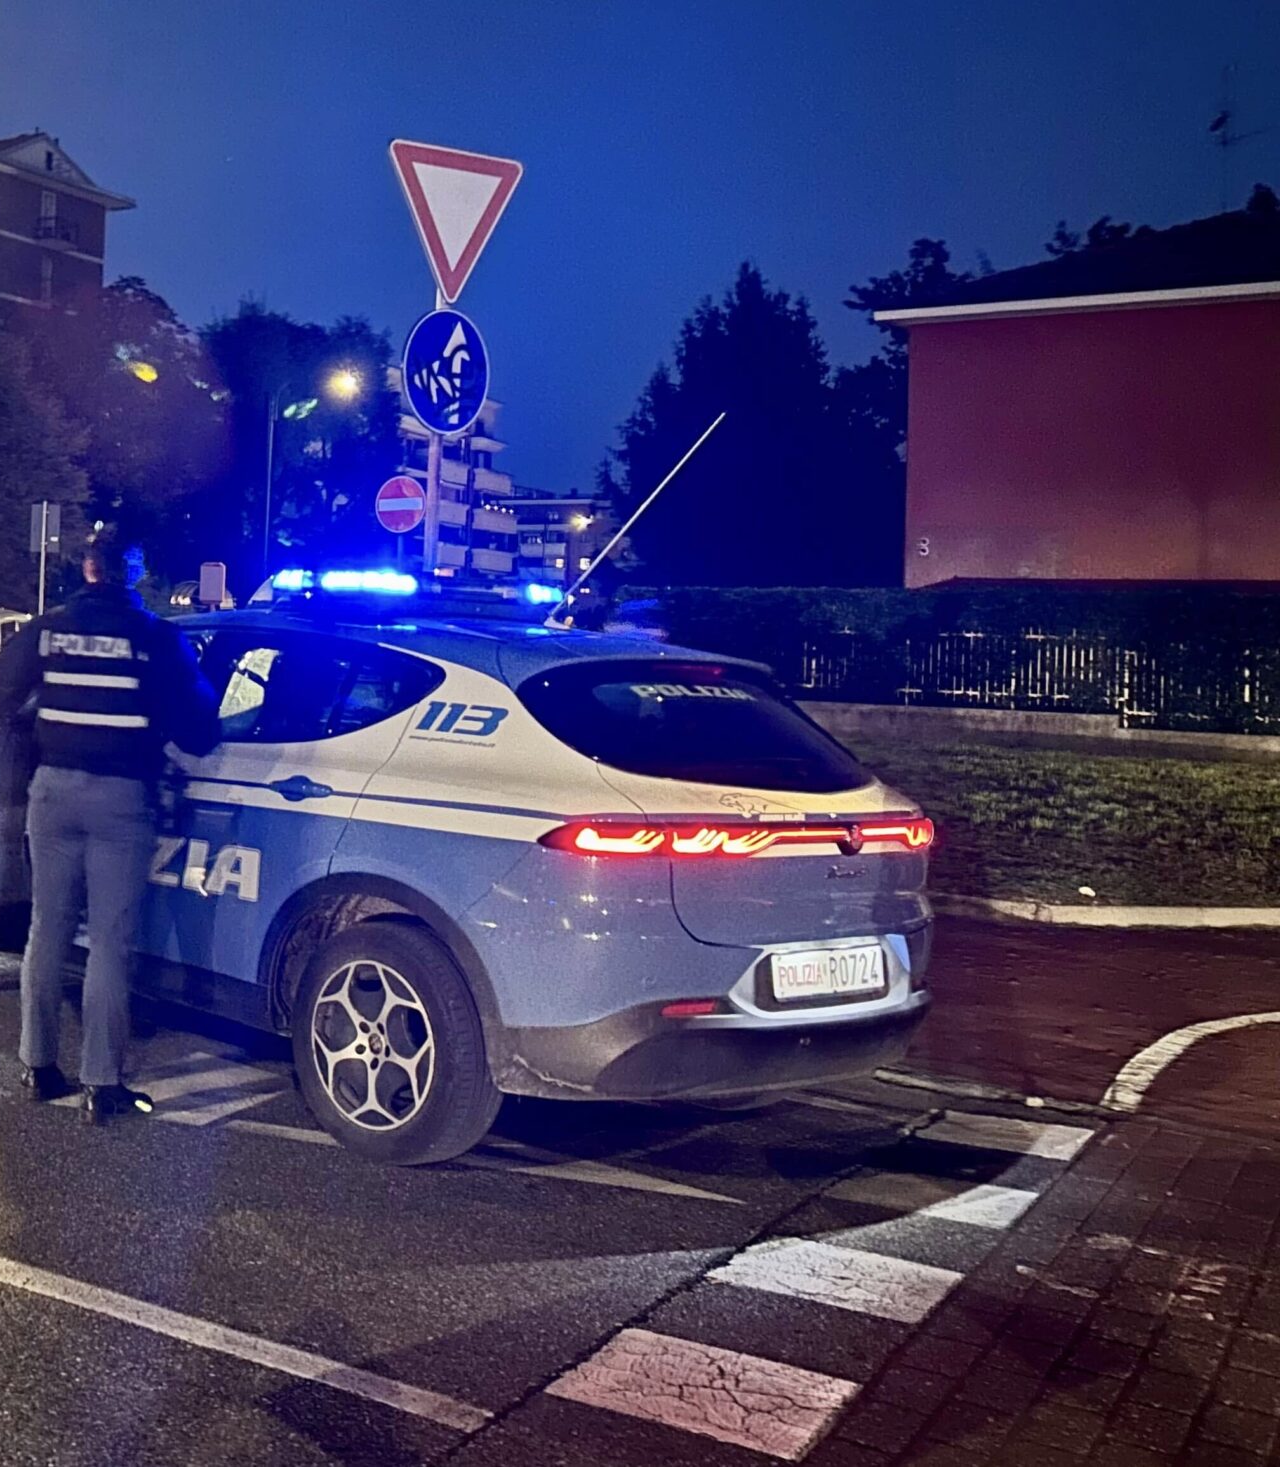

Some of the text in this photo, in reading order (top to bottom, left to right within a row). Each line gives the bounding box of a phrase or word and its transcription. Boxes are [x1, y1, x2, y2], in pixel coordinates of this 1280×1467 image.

[50, 632, 133, 659] POLIZIA
[629, 684, 759, 701] POLIZIA
[415, 700, 510, 737] 113
[147, 836, 262, 903] ZIA
[778, 951, 879, 988] POLIZIA R0724
